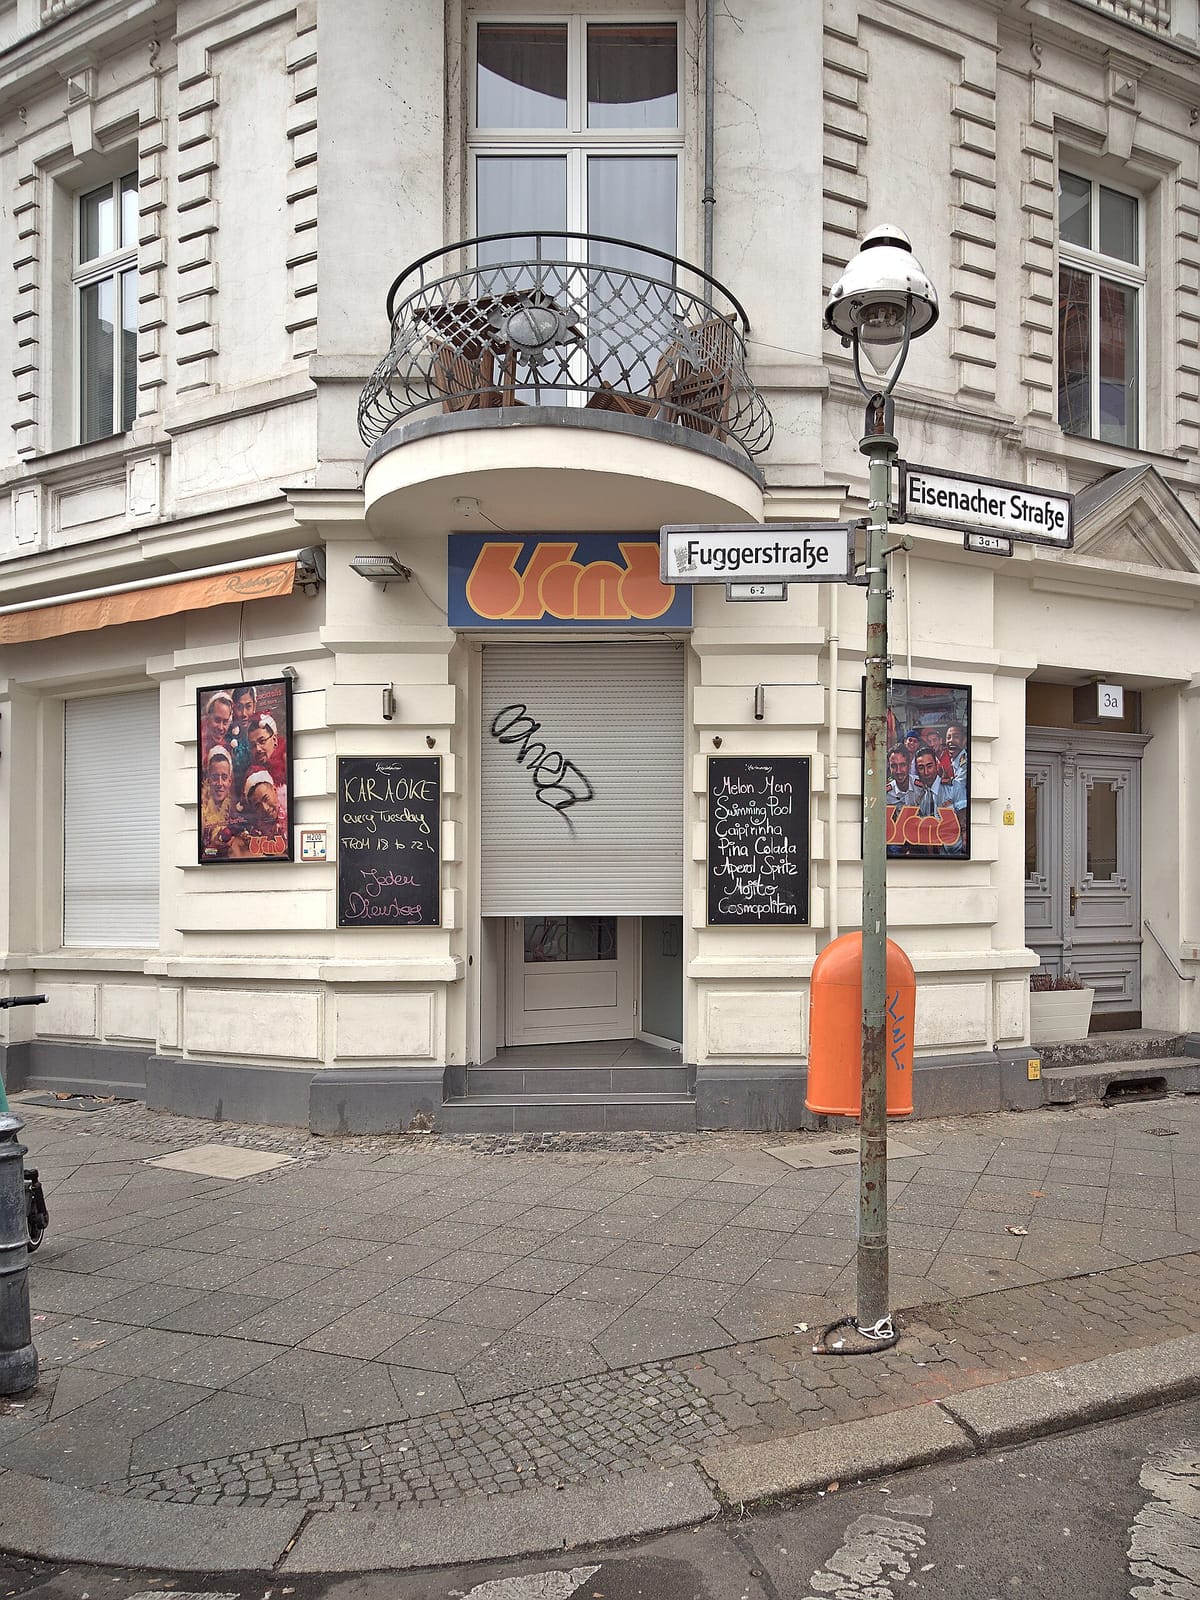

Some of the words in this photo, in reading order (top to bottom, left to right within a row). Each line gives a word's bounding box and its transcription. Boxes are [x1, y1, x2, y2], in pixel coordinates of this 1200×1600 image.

[909, 477, 1006, 516] Eisenacher
[1010, 495, 1065, 528] Straße
[687, 538, 829, 571] Fuggerstraße
[978, 536, 999, 548] 3a-1
[750, 586, 765, 595] 6-2
[1103, 693, 1119, 708] 3a
[344, 776, 437, 803] KARAOKE
[713, 776, 755, 796] Melon
[758, 775, 793, 795] Man
[766, 795, 792, 816] Pool
[342, 813, 377, 833] every
[371, 807, 431, 834] Tuesday
[715, 817, 783, 841] Caipirinha
[341, 837, 370, 850] FROM
[755, 836, 797, 855] Colada
[713, 855, 756, 880] Aperol
[760, 854, 798, 880] Spritz
[360, 868, 421, 898] Jeden
[724, 873, 779, 900] Mojito
[718, 893, 797, 919] Cosmopolitan
